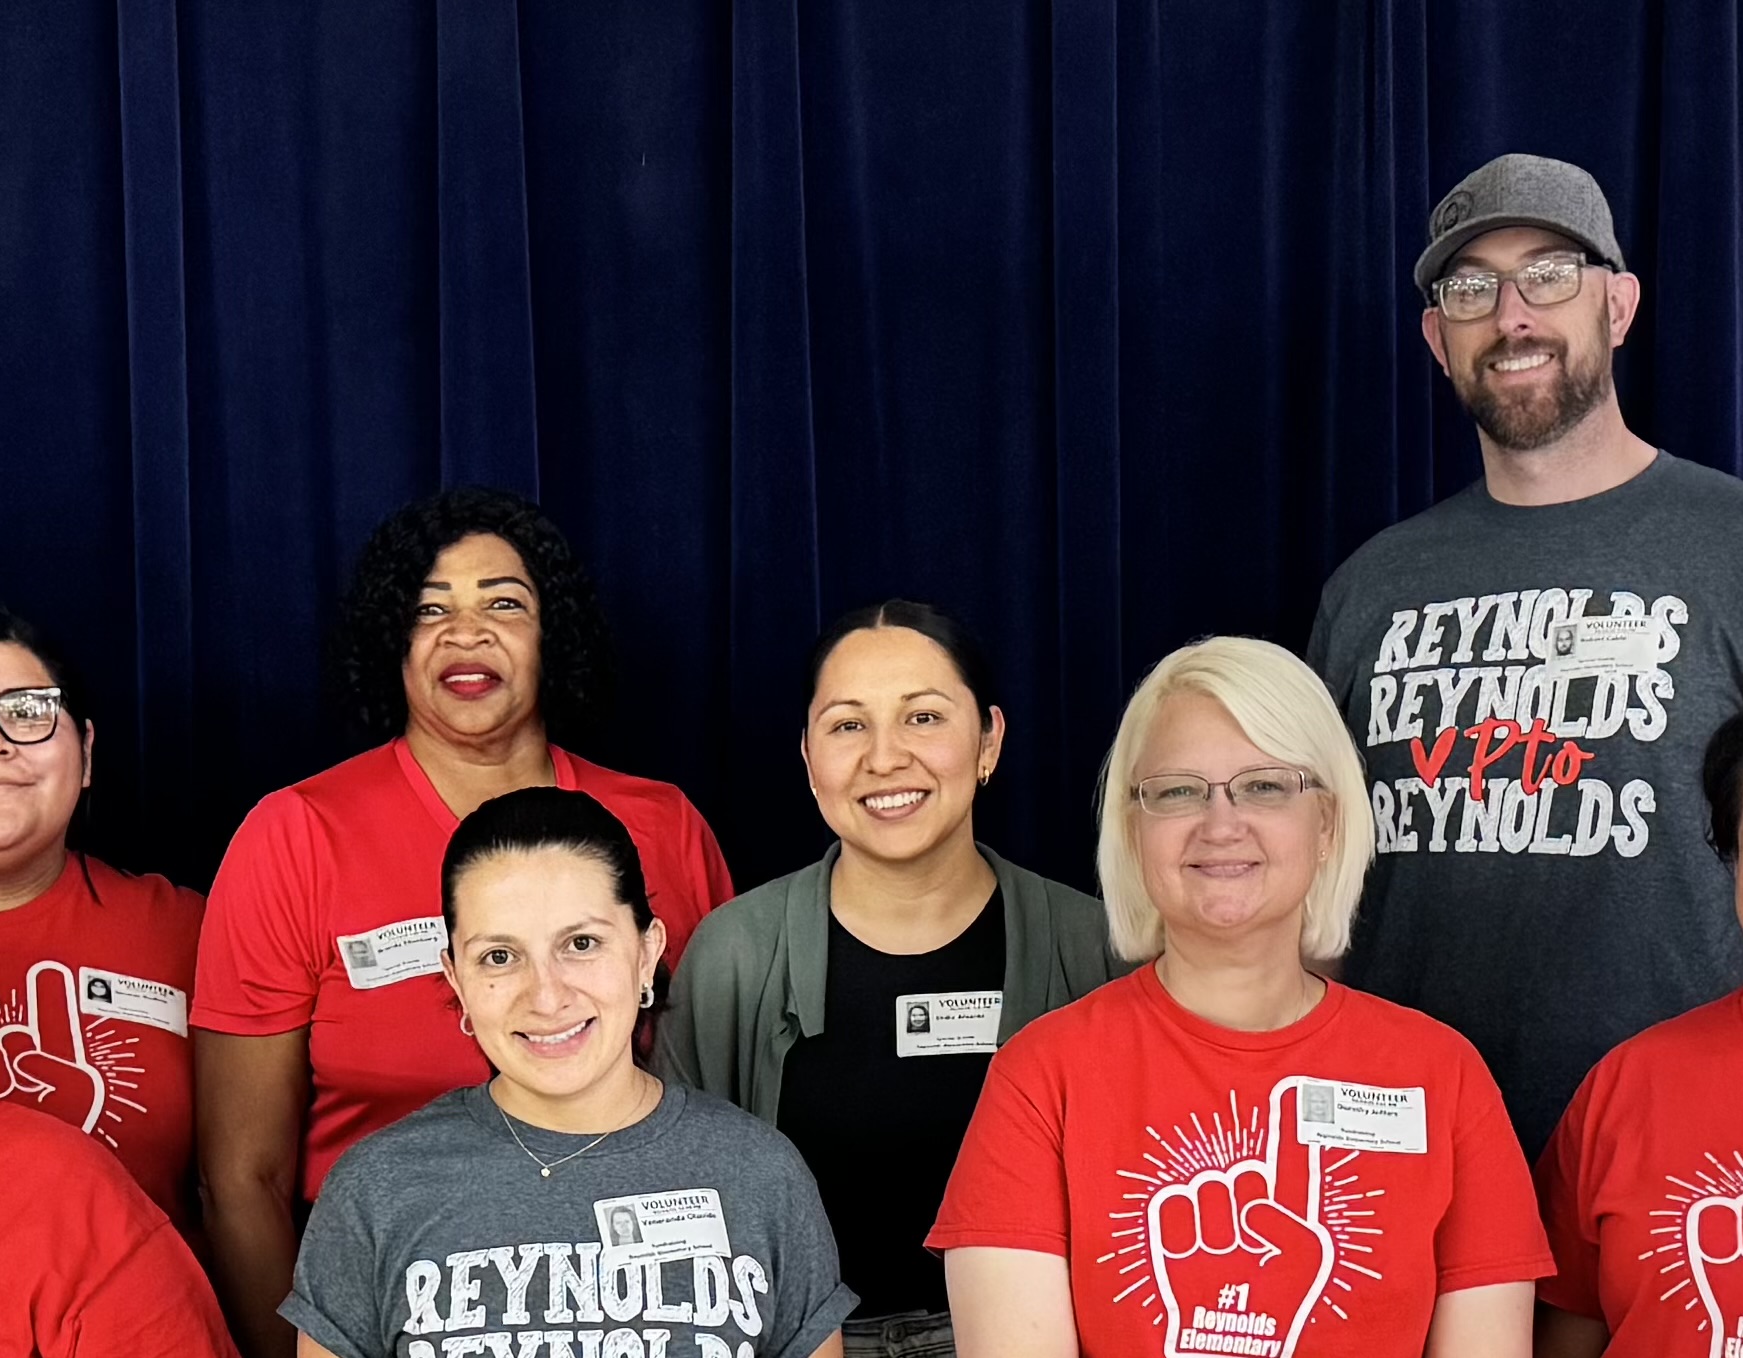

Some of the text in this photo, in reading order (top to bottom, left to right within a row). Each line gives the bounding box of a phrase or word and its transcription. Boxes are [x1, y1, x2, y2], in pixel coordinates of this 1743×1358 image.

[1366, 665, 1674, 747] REYNOLDS
[1464, 718, 1595, 801] Pto
[1372, 777, 1656, 859] REYNOLDS
[1341, 1087, 1408, 1103] VOLUNTEER
[641, 1195, 709, 1211] VOLUNTEER
[402, 1242, 769, 1336] REYNOLDS
[1218, 1282, 1250, 1312] #1
[1192, 1306, 1277, 1336] Reynolds
[1180, 1327, 1282, 1358] Elementary
